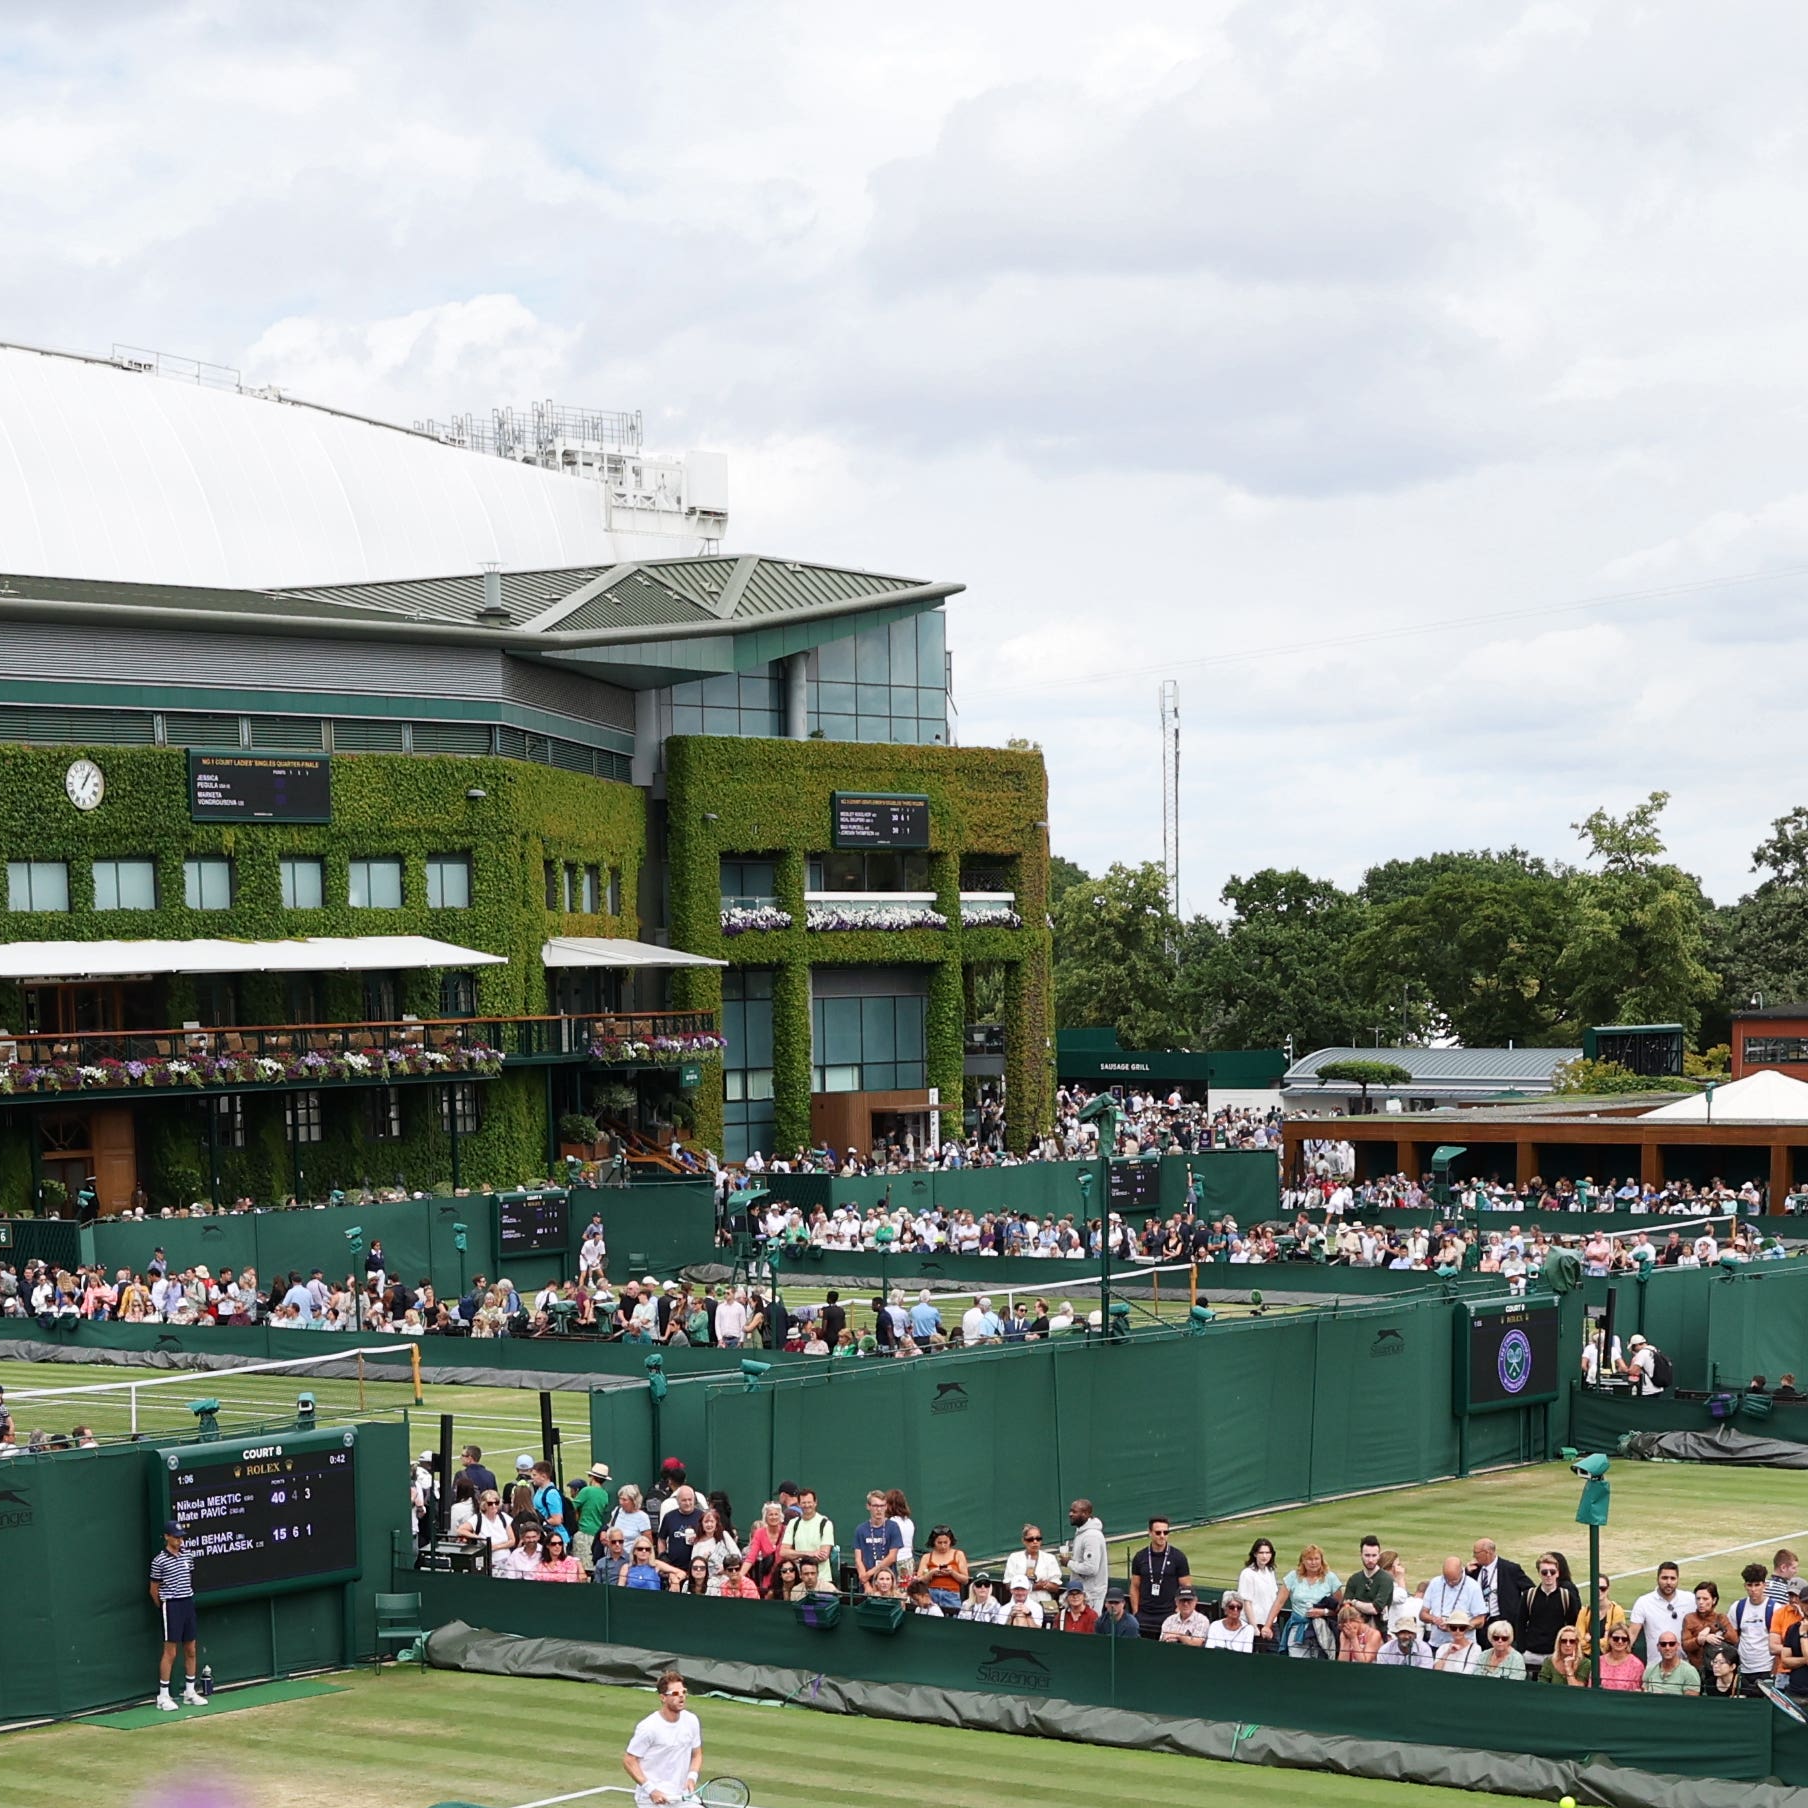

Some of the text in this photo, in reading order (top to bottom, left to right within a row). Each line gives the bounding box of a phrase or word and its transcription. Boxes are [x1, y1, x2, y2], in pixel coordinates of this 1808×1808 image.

[1100, 1063, 1150, 1071] SAUSAGE GRILL
[0, 1232, 7, 1242] 6
[1505, 1305, 1521, 1313] COURT
[242, 1446, 282, 1460] COURT 8
[329, 1454, 346, 1465] 0:42
[246, 1463, 280, 1476] ROLEX
[176, 1499, 205, 1511] Nikola
[207, 1493, 242, 1507] MEKTIC
[270, 1488, 311, 1504] 40 4 3
[177, 1512, 199, 1522] Mate
[200, 1507, 227, 1519] PAVIC
[201, 1532, 234, 1546] BEHAR
[272, 1524, 312, 1541] 15 6 1
[206, 1539, 254, 1556] PAVLASEK
[975, 1664, 1050, 1689] Slazenger
